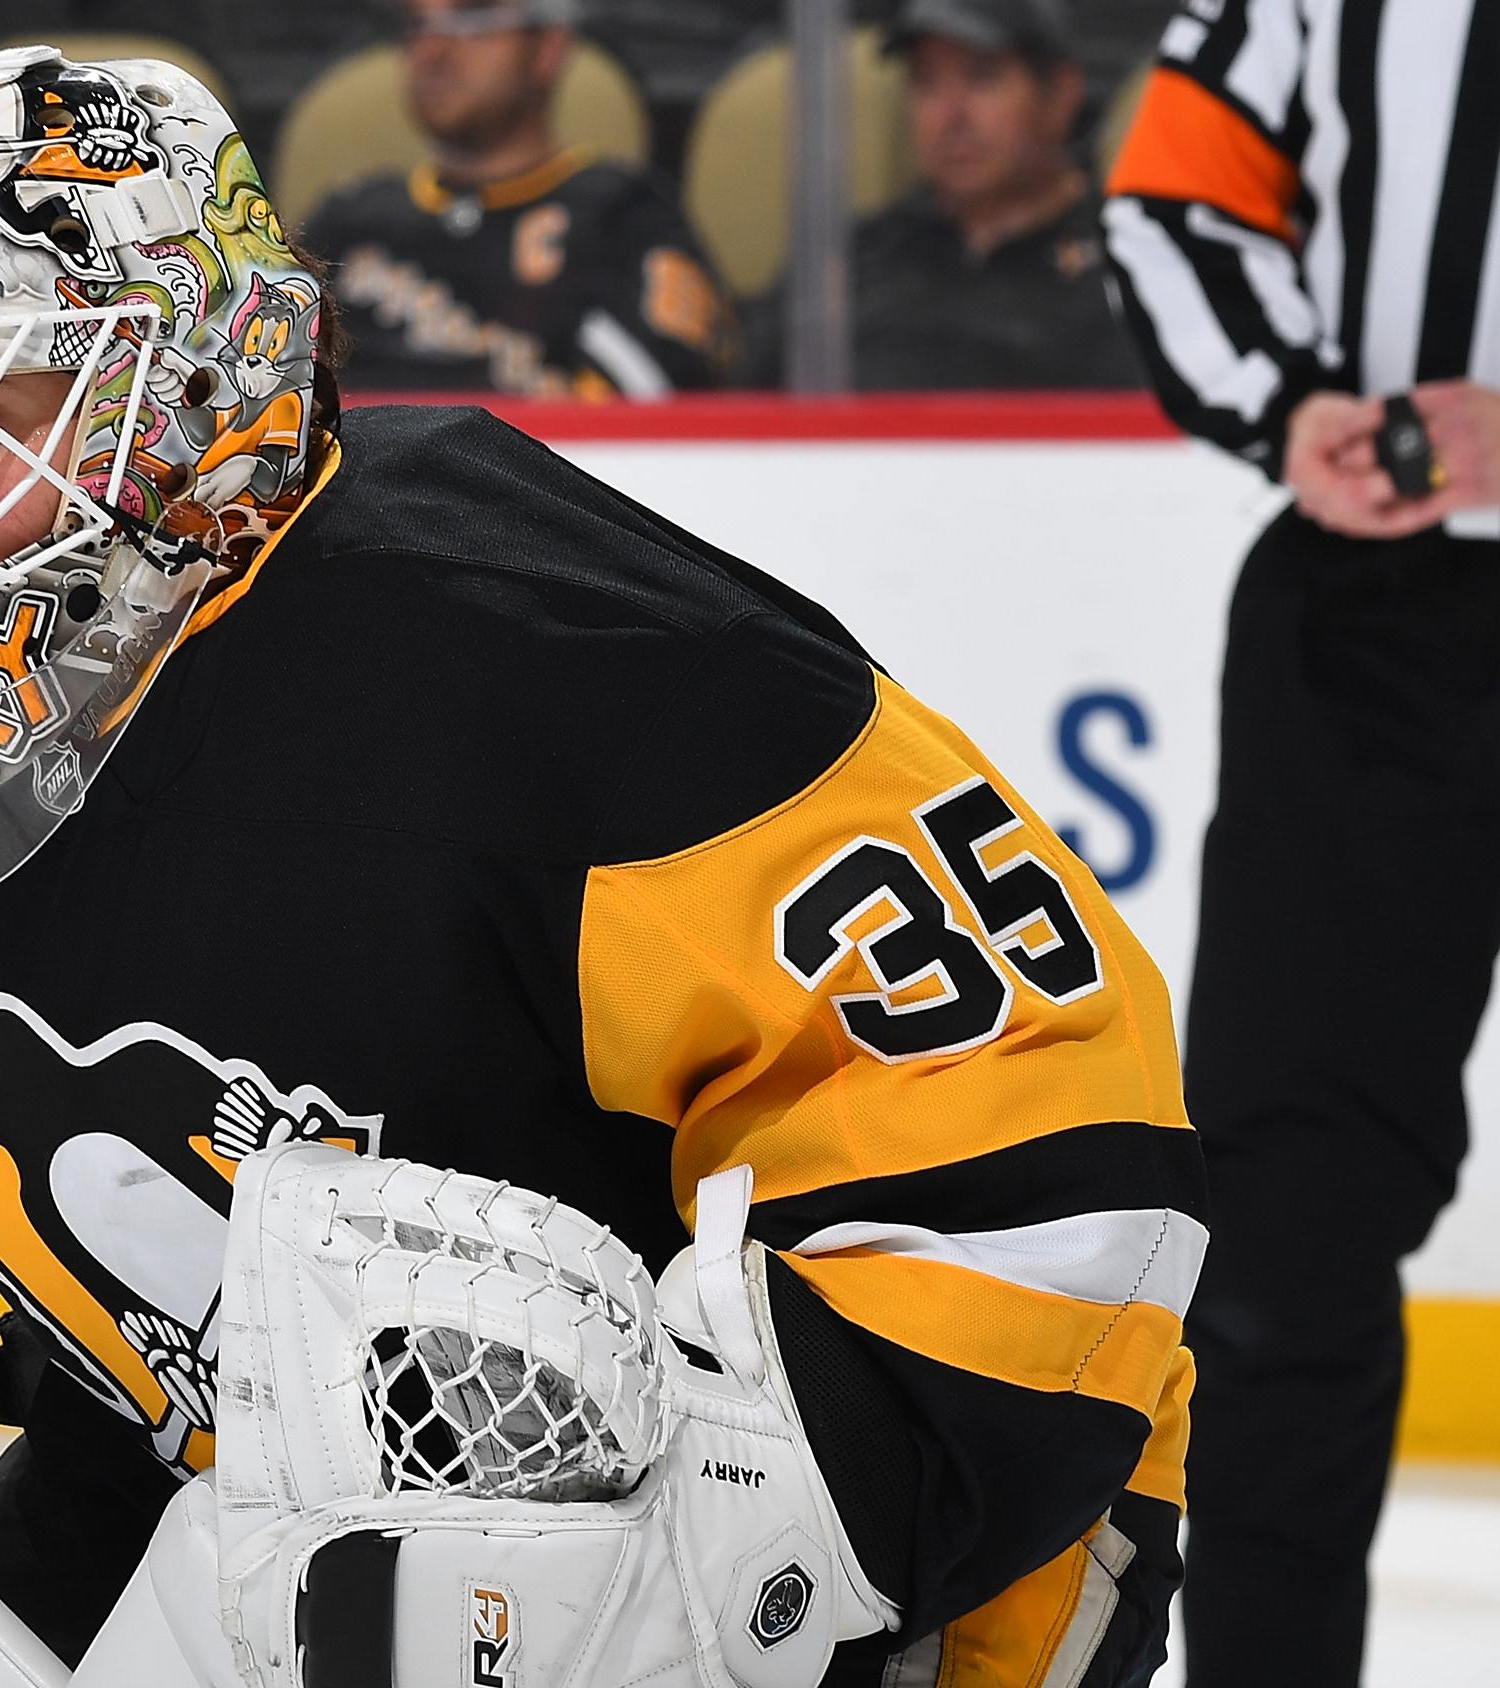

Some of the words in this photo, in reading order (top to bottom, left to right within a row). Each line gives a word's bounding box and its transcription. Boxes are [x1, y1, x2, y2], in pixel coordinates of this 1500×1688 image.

[46, 762, 75, 799] NHL
[1054, 690, 1159, 894] S
[773, 774, 1106, 1067] 35
[700, 1459, 766, 1489] JARRY
